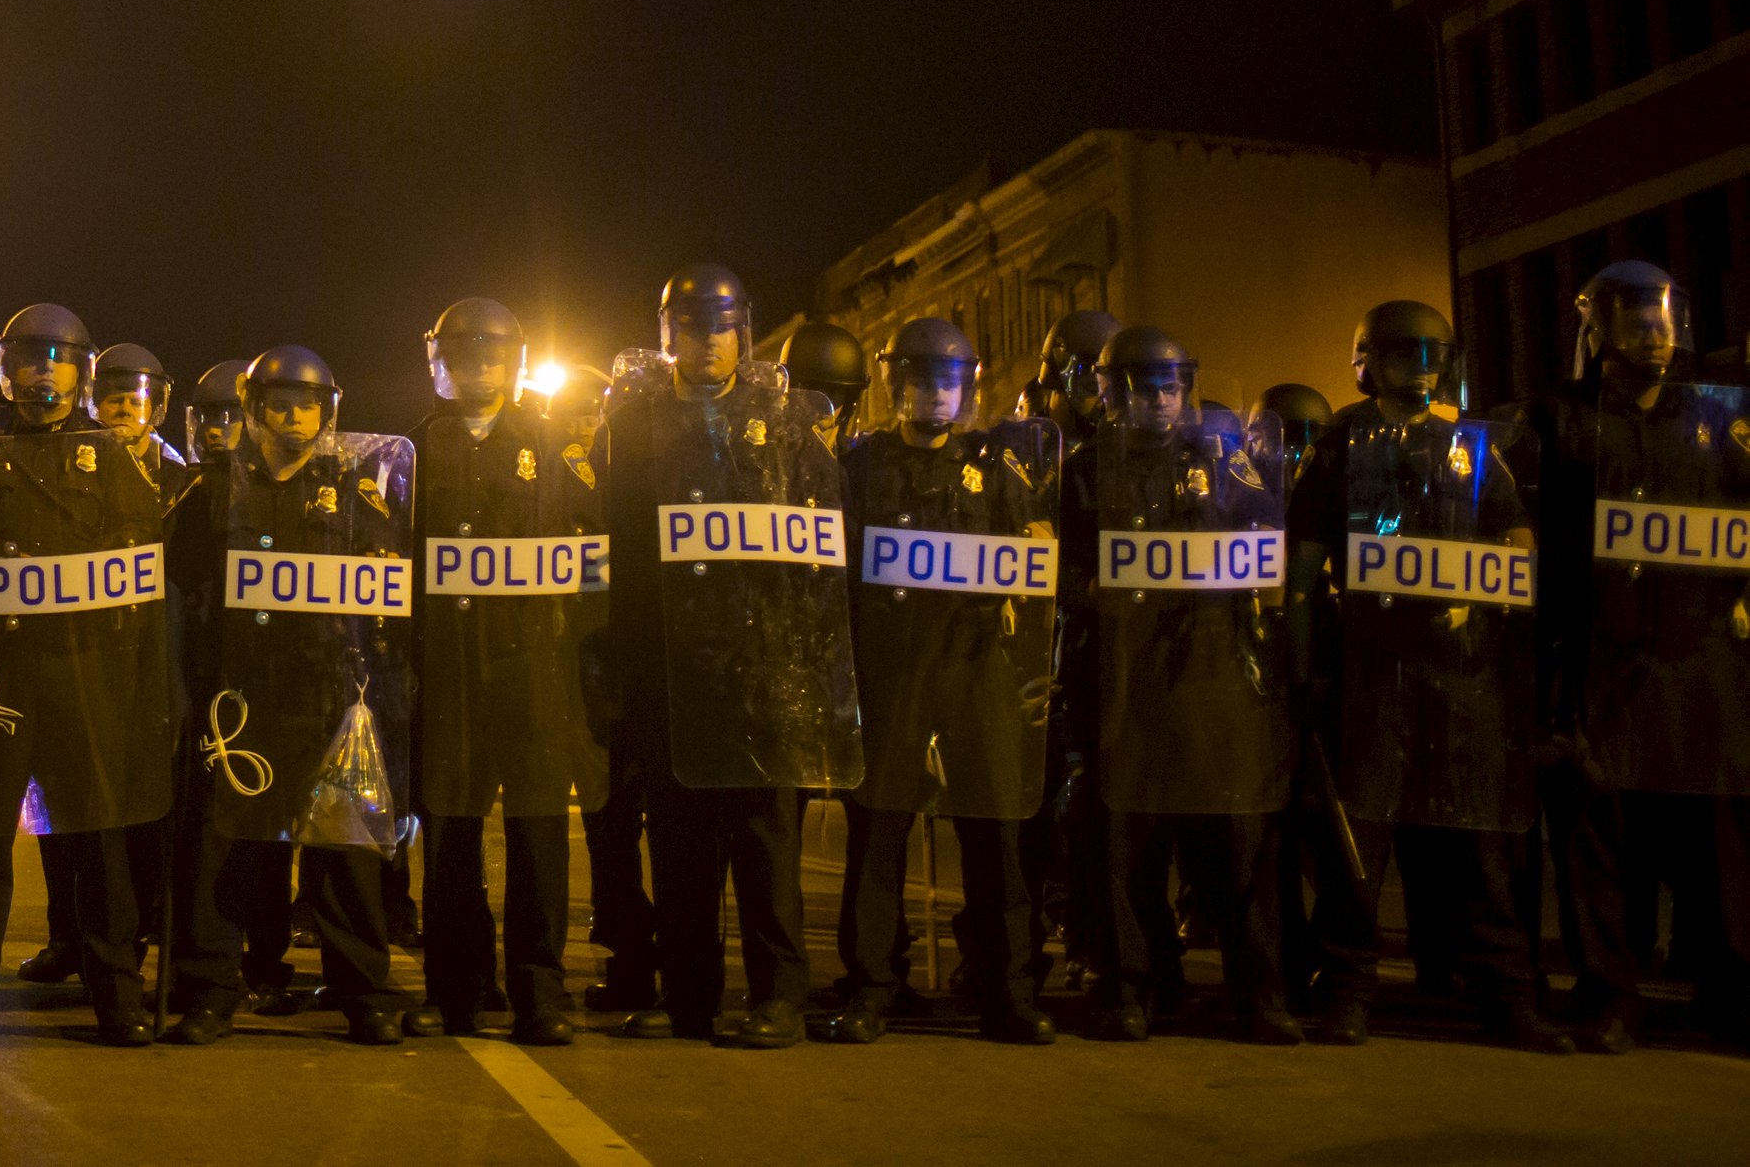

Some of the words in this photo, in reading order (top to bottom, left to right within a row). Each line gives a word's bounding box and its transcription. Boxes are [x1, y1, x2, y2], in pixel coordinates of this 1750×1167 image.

[670, 510, 836, 557] POLICE
[1606, 509, 1747, 559] POLIC
[236, 558, 404, 607] POLICE
[436, 542, 601, 587] POLICE
[872, 535, 1049, 588] POLICE
[1111, 537, 1277, 581] POLICE
[1358, 540, 1530, 597] POLICE
